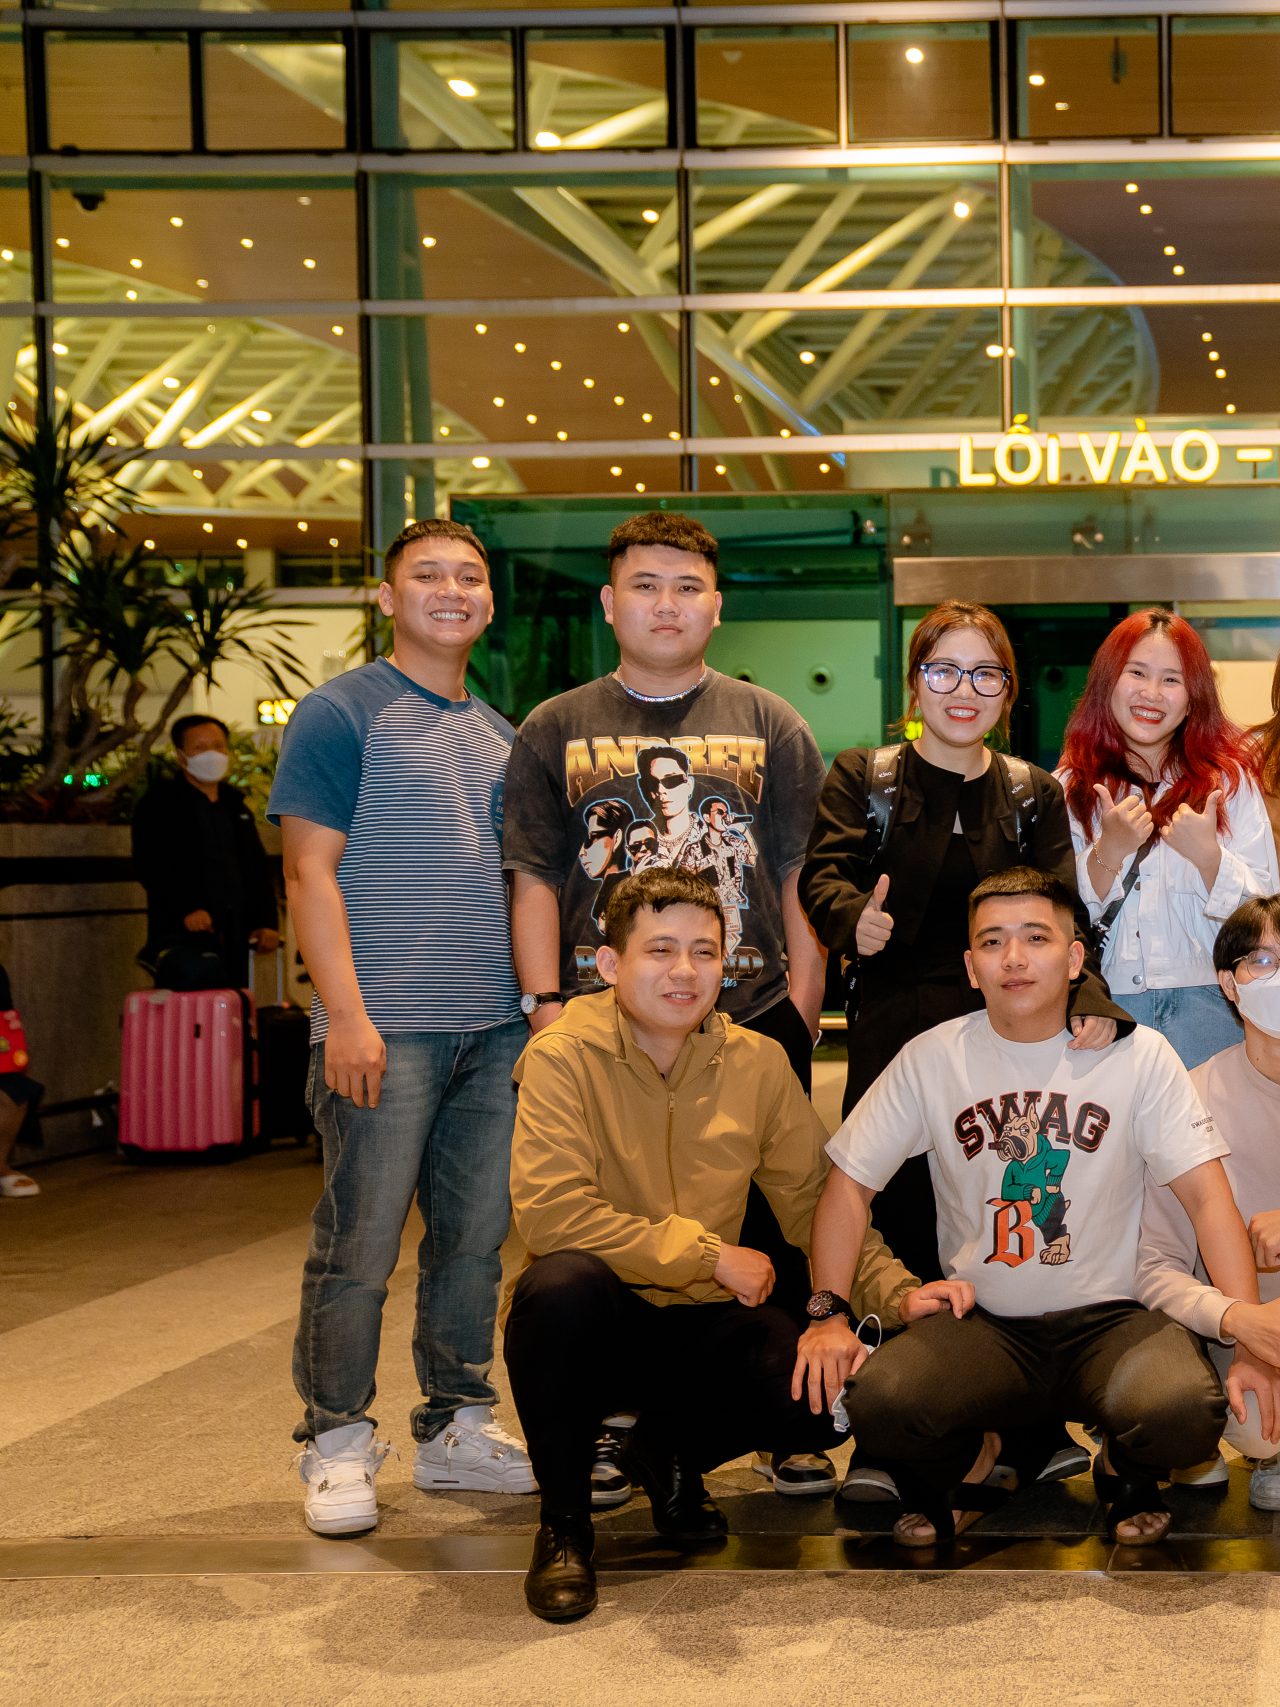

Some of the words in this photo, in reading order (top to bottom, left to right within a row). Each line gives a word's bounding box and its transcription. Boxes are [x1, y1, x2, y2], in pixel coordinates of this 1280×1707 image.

[1078, 419, 1220, 483] VÀO
[565, 735, 766, 807] ANREE
[954, 1090, 1111, 1161] SWAG
[982, 1197, 1035, 1269] B
